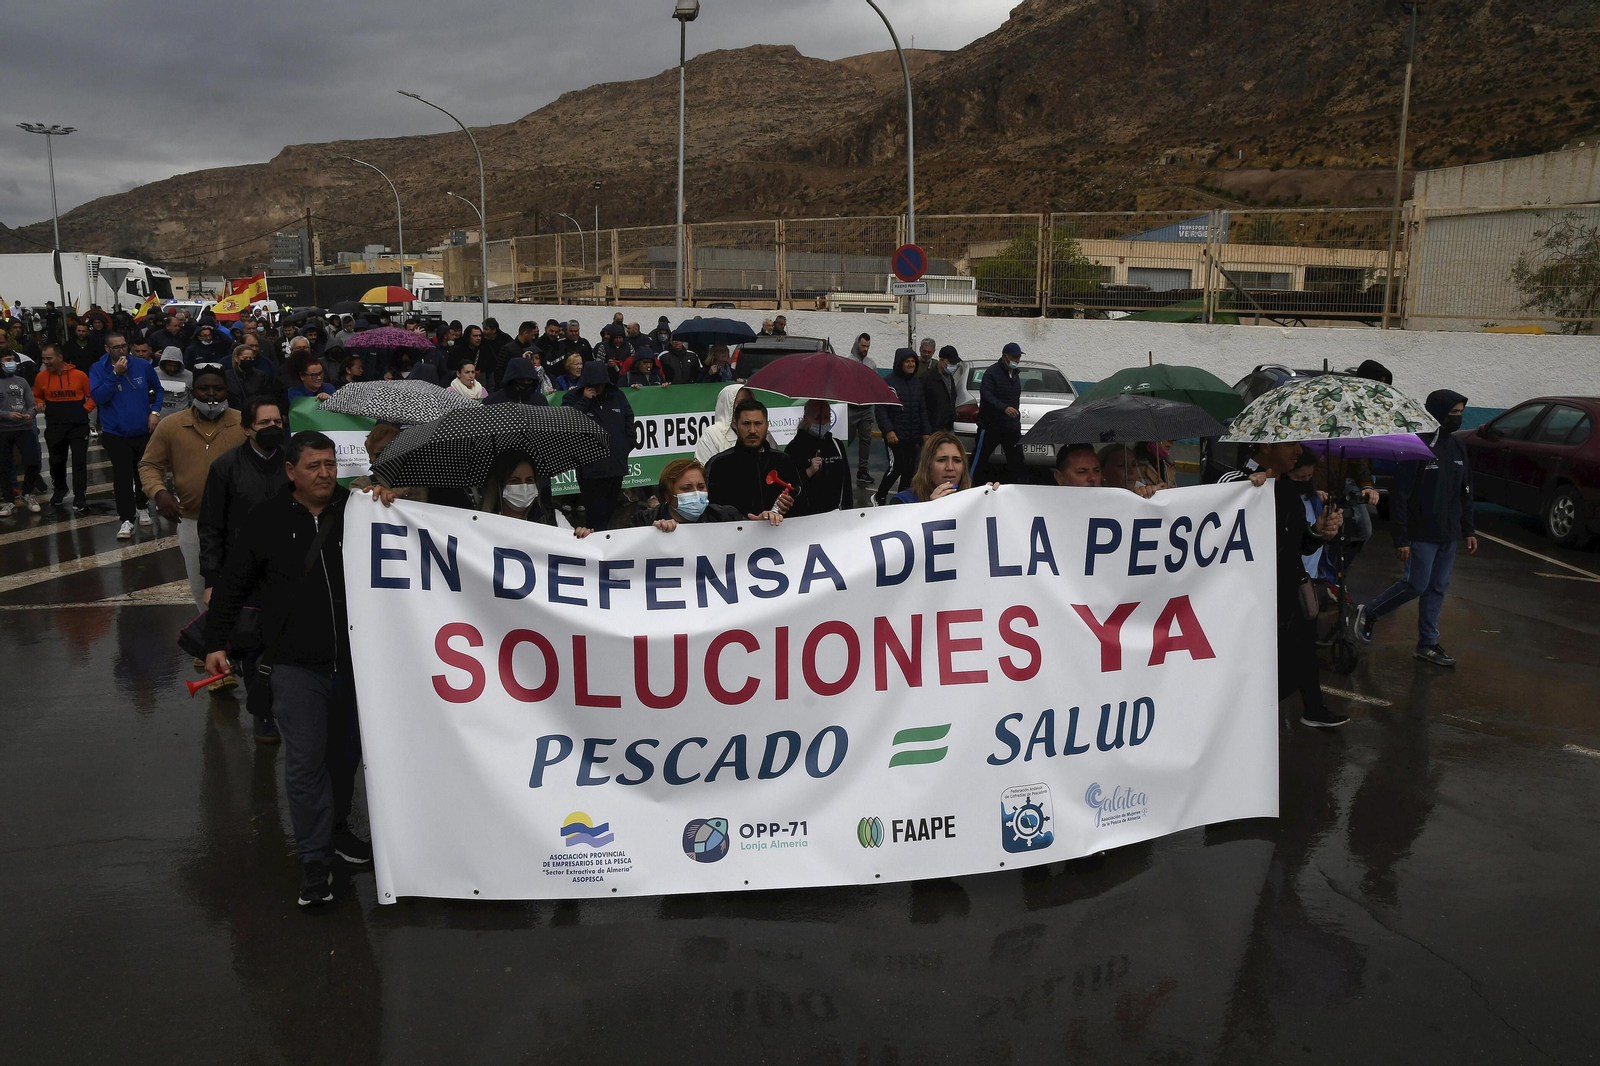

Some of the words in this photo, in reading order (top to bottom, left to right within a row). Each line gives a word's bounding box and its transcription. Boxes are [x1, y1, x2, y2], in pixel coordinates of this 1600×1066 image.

[1030, 444, 1046, 453] DHG
[371, 522, 461, 592] EN
[493, 543, 847, 610] DEFENSA
[870, 518, 956, 587] DE
[986, 516, 1060, 577] LA
[1084, 508, 1254, 576] PESCA
[432, 604, 1042, 709] SOLUCIONES
[1070, 594, 1216, 673] YA
[529, 725, 849, 788] PESCADO
[986, 696, 1155, 766] SALUD
[1085, 782, 1149, 828] Galatea
[739, 821, 807, 839] OPP-71
[892, 815, 956, 843] FAAPE
[549, 852, 588, 861] ASOCIACIÓN
[590, 850, 626, 859] PROVINCIAL
[741, 841, 767, 851] Lonja
[770, 839, 808, 849] Almería
[552, 860, 594, 868] EMPRESARIOS
